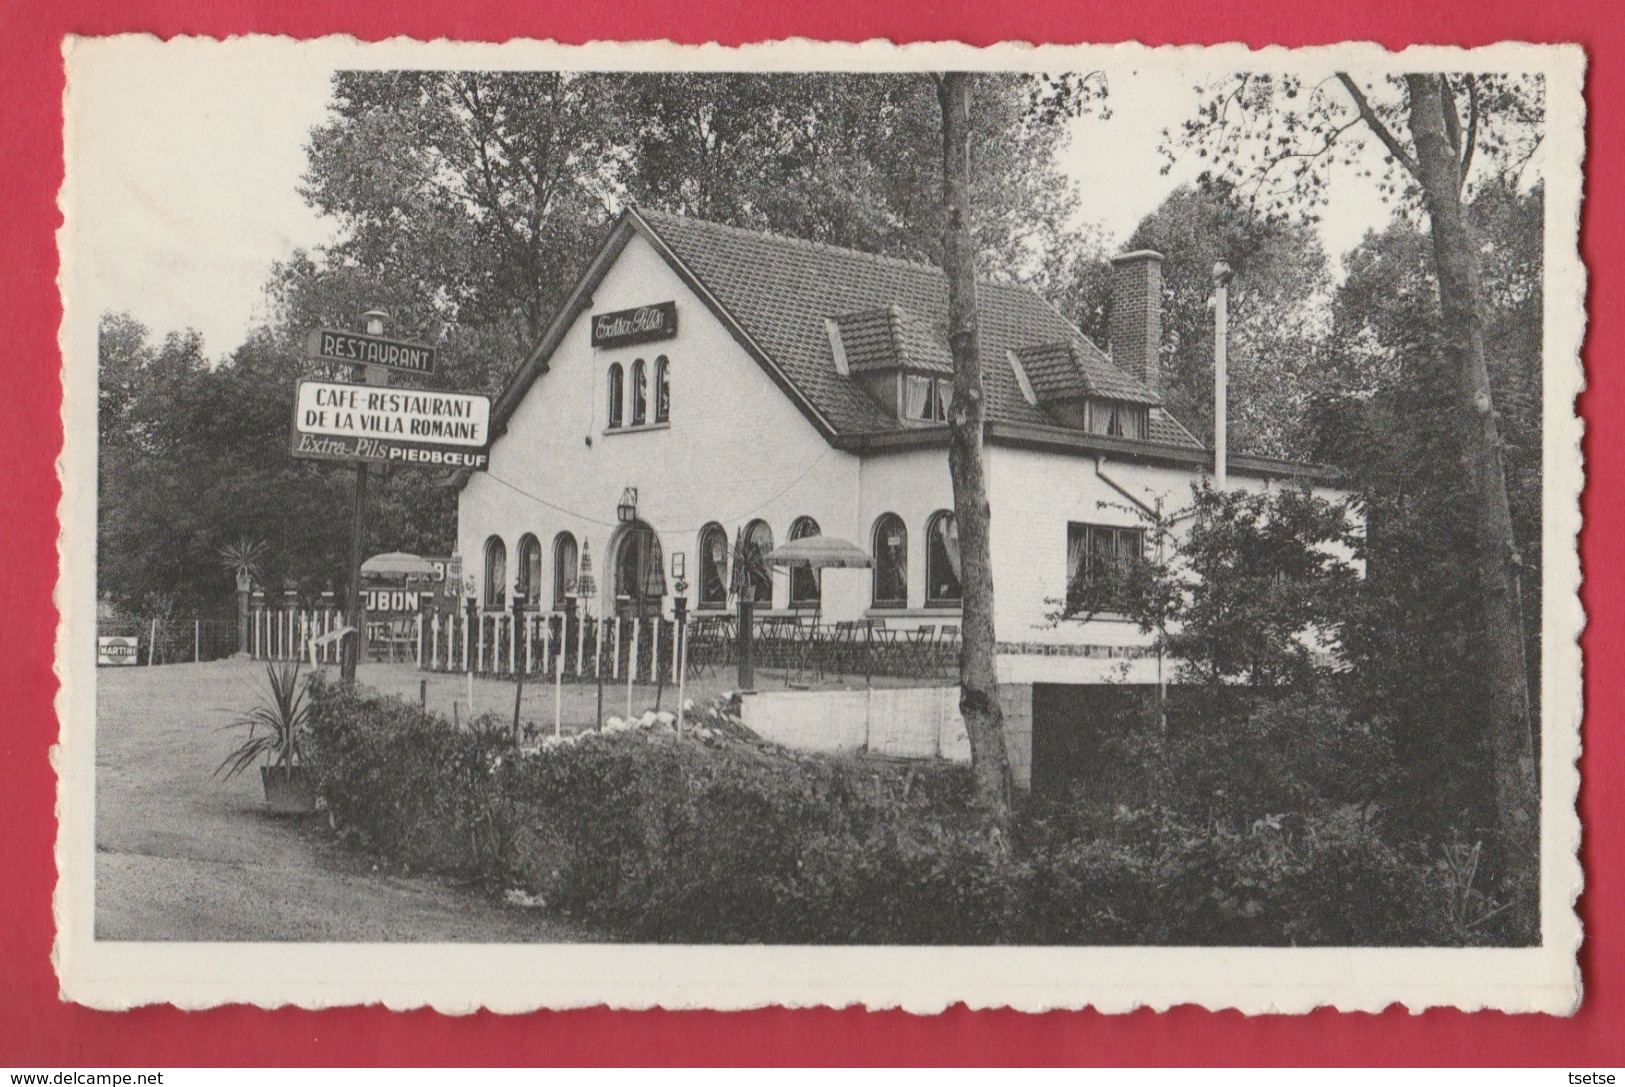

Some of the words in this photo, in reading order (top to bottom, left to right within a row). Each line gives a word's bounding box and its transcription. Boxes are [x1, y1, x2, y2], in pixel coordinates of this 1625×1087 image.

[324, 335, 430, 370] RESTAURANT
[316, 388, 474, 419] CAFE-RESTAURANT
[305, 410, 328, 428] DE
[334, 412, 354, 430] LA
[360, 414, 404, 434] VILLA
[410, 418, 480, 440] ROMAINE
[389, 447, 487, 467] PIEDBŒUF
[100, 646, 136, 655] MARTINI
